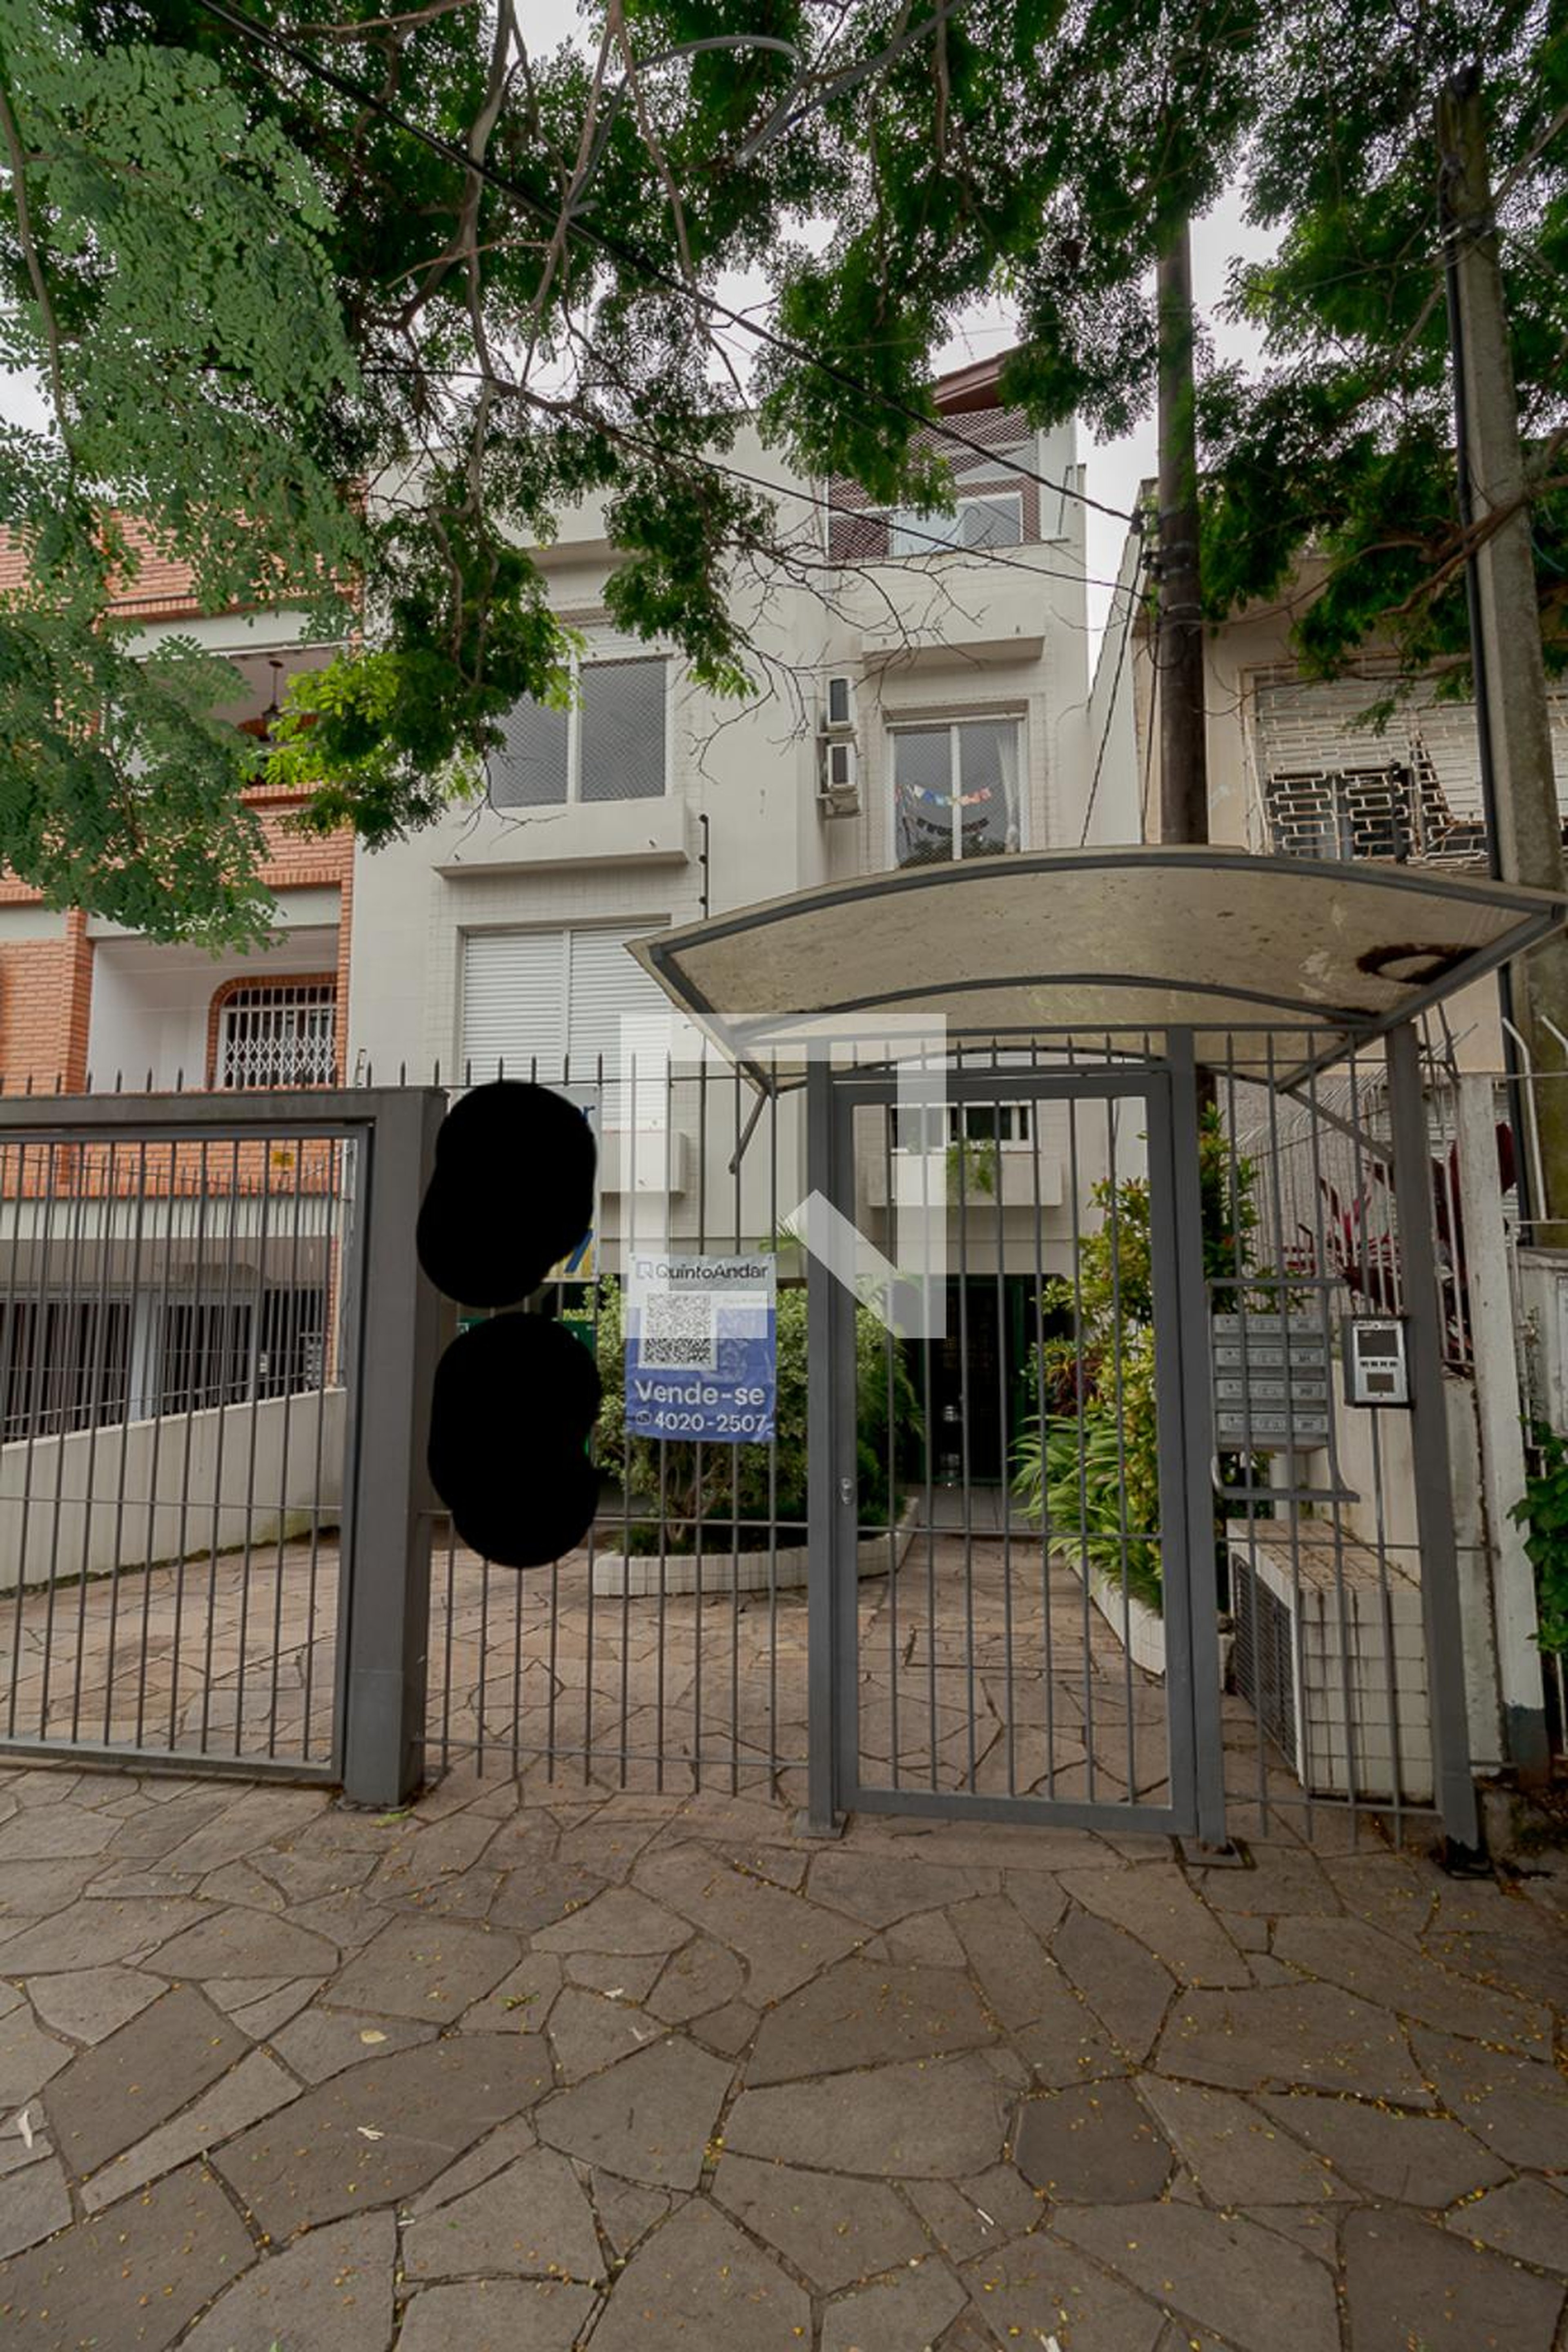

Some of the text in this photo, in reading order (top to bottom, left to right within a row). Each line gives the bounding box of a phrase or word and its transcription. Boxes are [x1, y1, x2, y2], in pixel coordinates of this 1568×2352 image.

[655, 1264, 768, 1279] QuintoAndar
[635, 1379, 766, 1406] Vende-se
[655, 1412, 767, 1433] 4020-2507
